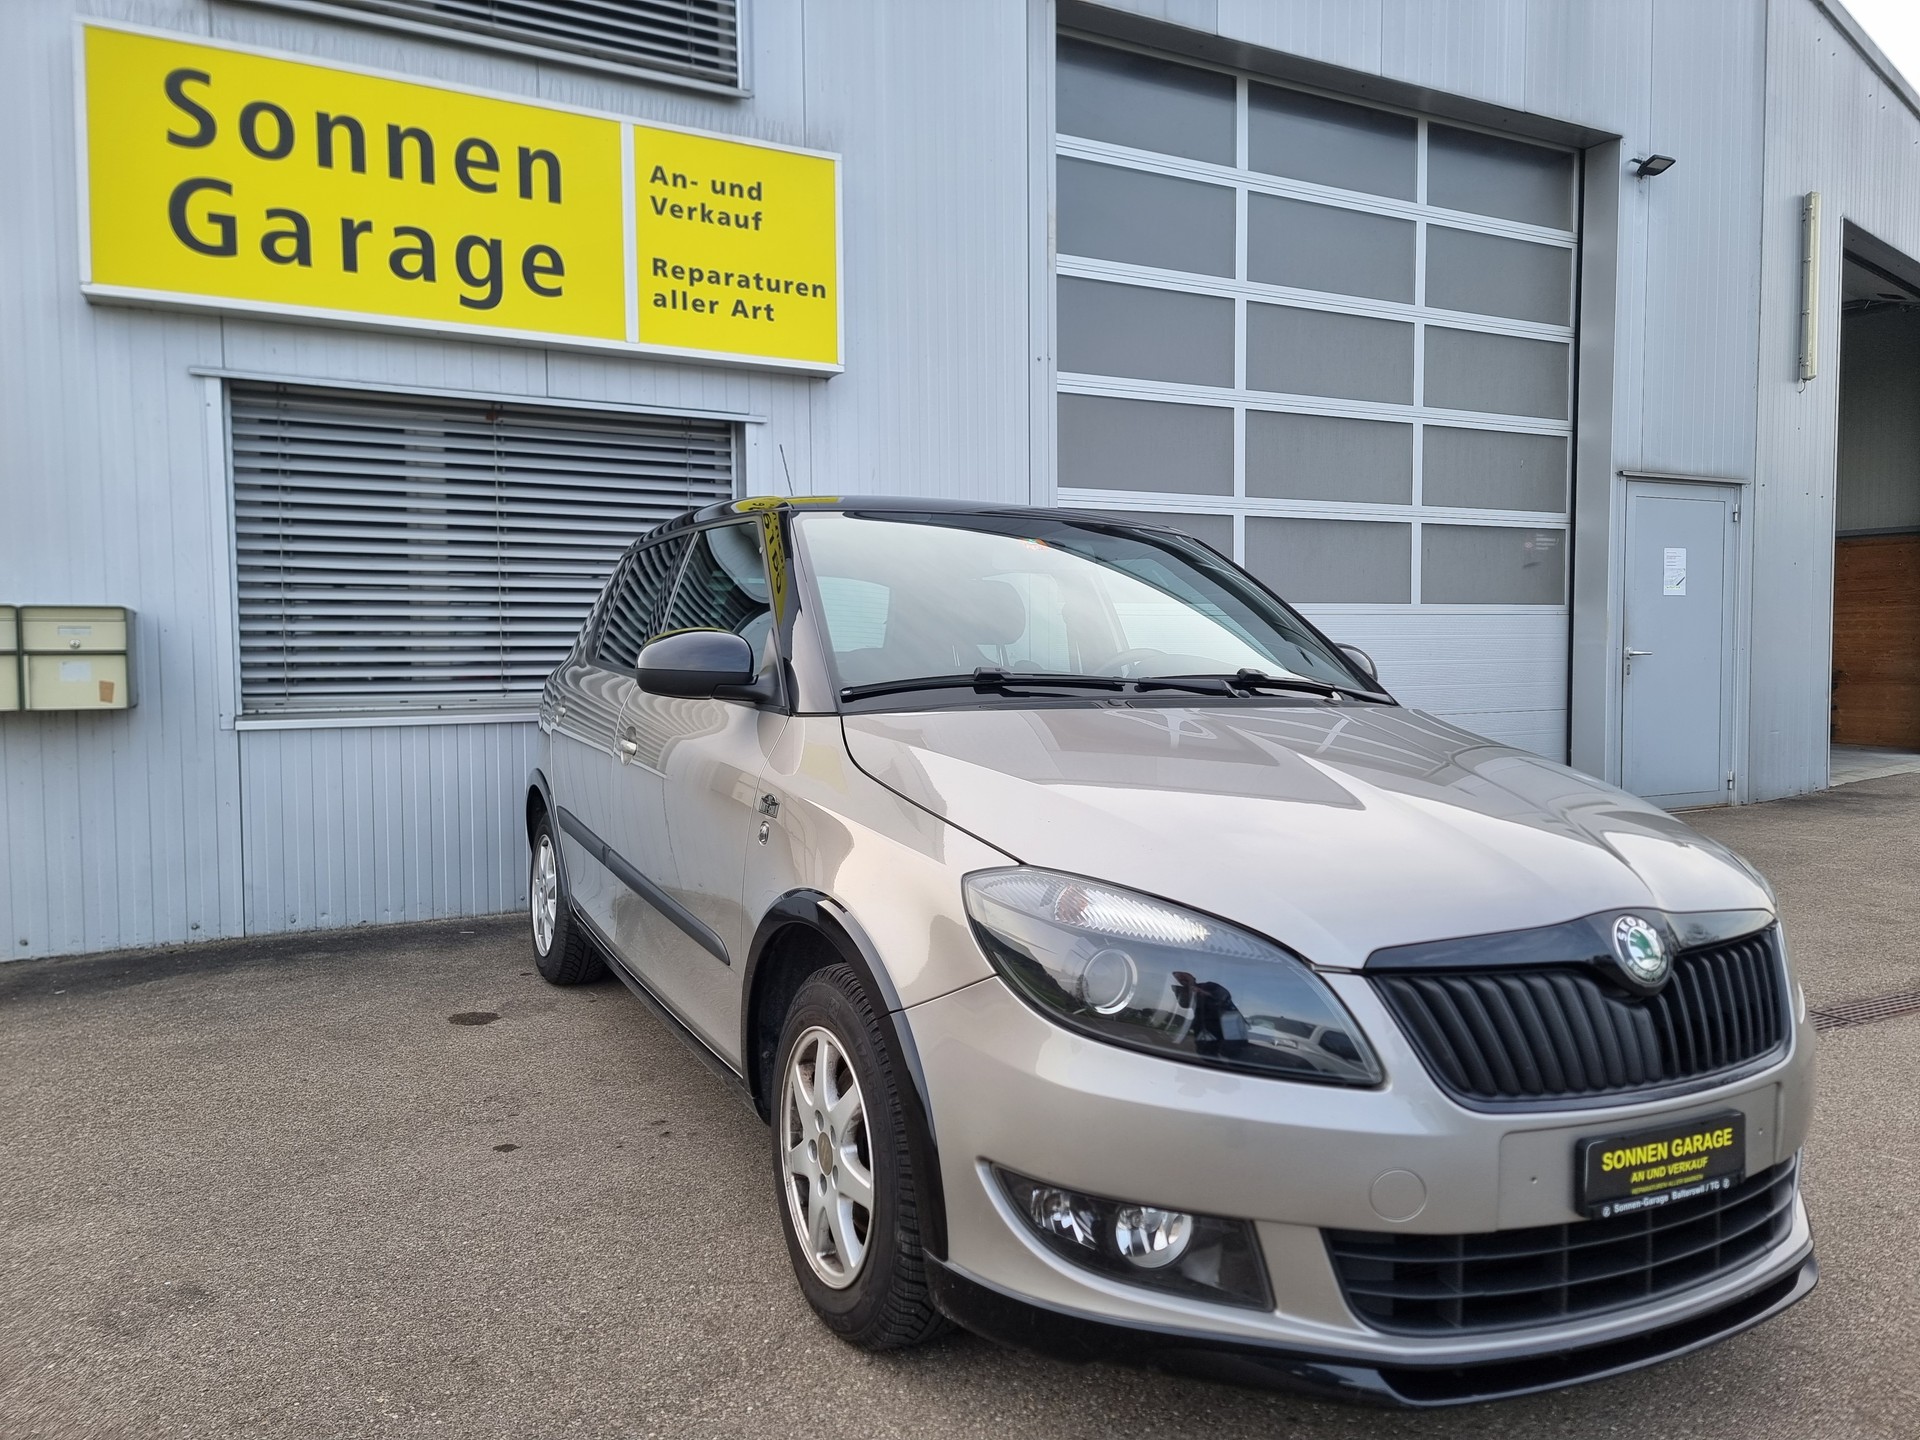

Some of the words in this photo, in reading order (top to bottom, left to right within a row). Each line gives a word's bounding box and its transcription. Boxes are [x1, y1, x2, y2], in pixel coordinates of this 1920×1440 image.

[164, 68, 563, 204] Sonnen
[650, 165, 699, 188] An-
[711, 179, 763, 202] und
[650, 195, 763, 231] Verkauf
[168, 177, 566, 310] Garage
[652, 257, 827, 299] Reparaturen
[652, 289, 718, 316] aller
[730, 299, 775, 322] Art
[1602, 1142, 1668, 1171] SONNEN
[1671, 1128, 1733, 1157] GARAGE
[1631, 1171, 1645, 1183] AN
[1646, 1166, 1666, 1180] UND
[1668, 1156, 1709, 1175] VERKAUF
[1614, 1194, 1669, 1213] Sonnen-Garage
[1710, 1180, 1720, 1190] TG
